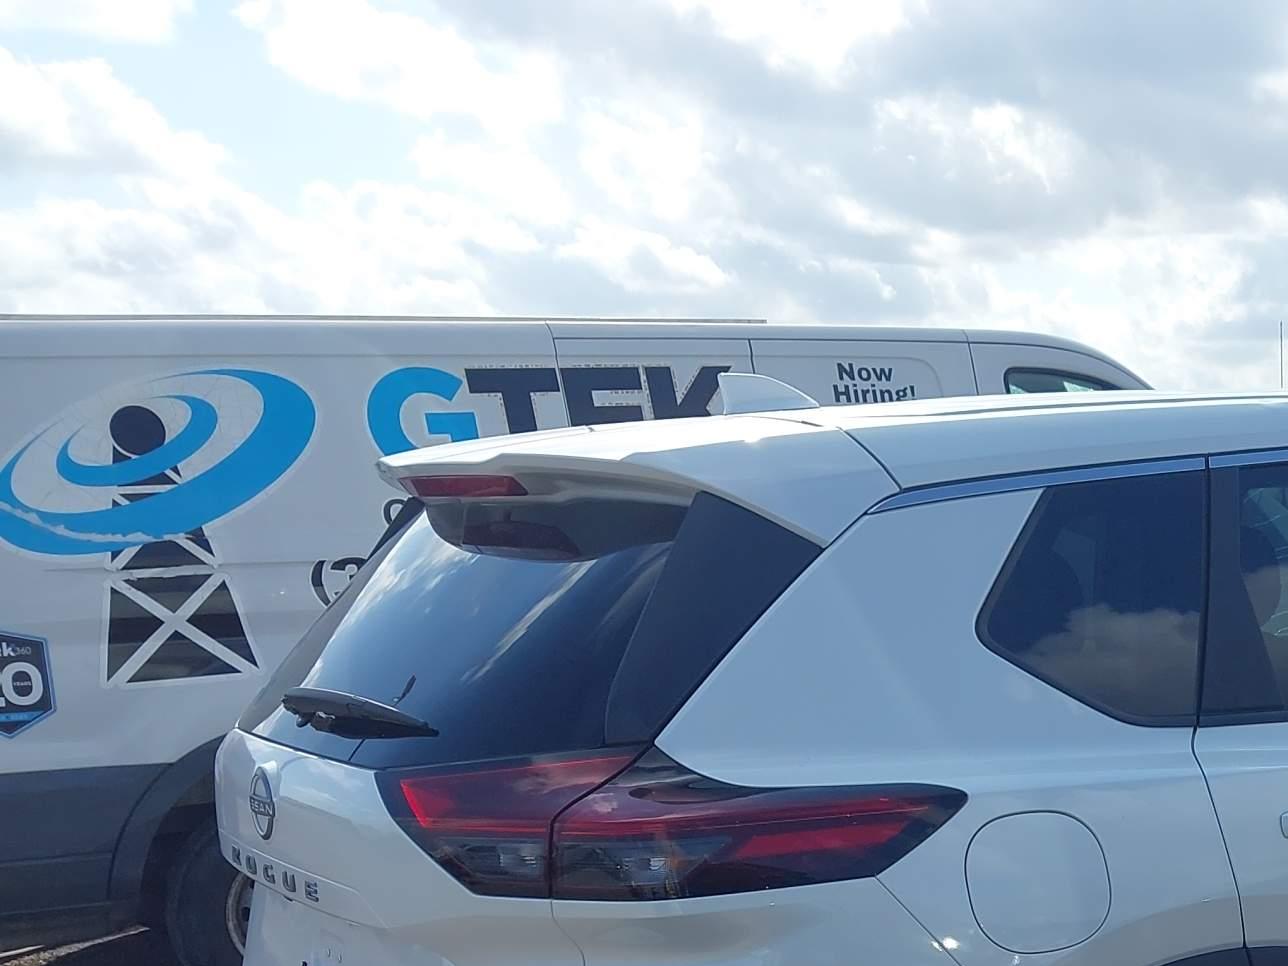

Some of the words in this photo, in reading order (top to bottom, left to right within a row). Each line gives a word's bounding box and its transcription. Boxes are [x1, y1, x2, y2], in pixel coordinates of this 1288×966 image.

[837, 362, 893, 382] Now
[832, 383, 916, 403] Hiring!
[231, 844, 320, 903] ROGUE
